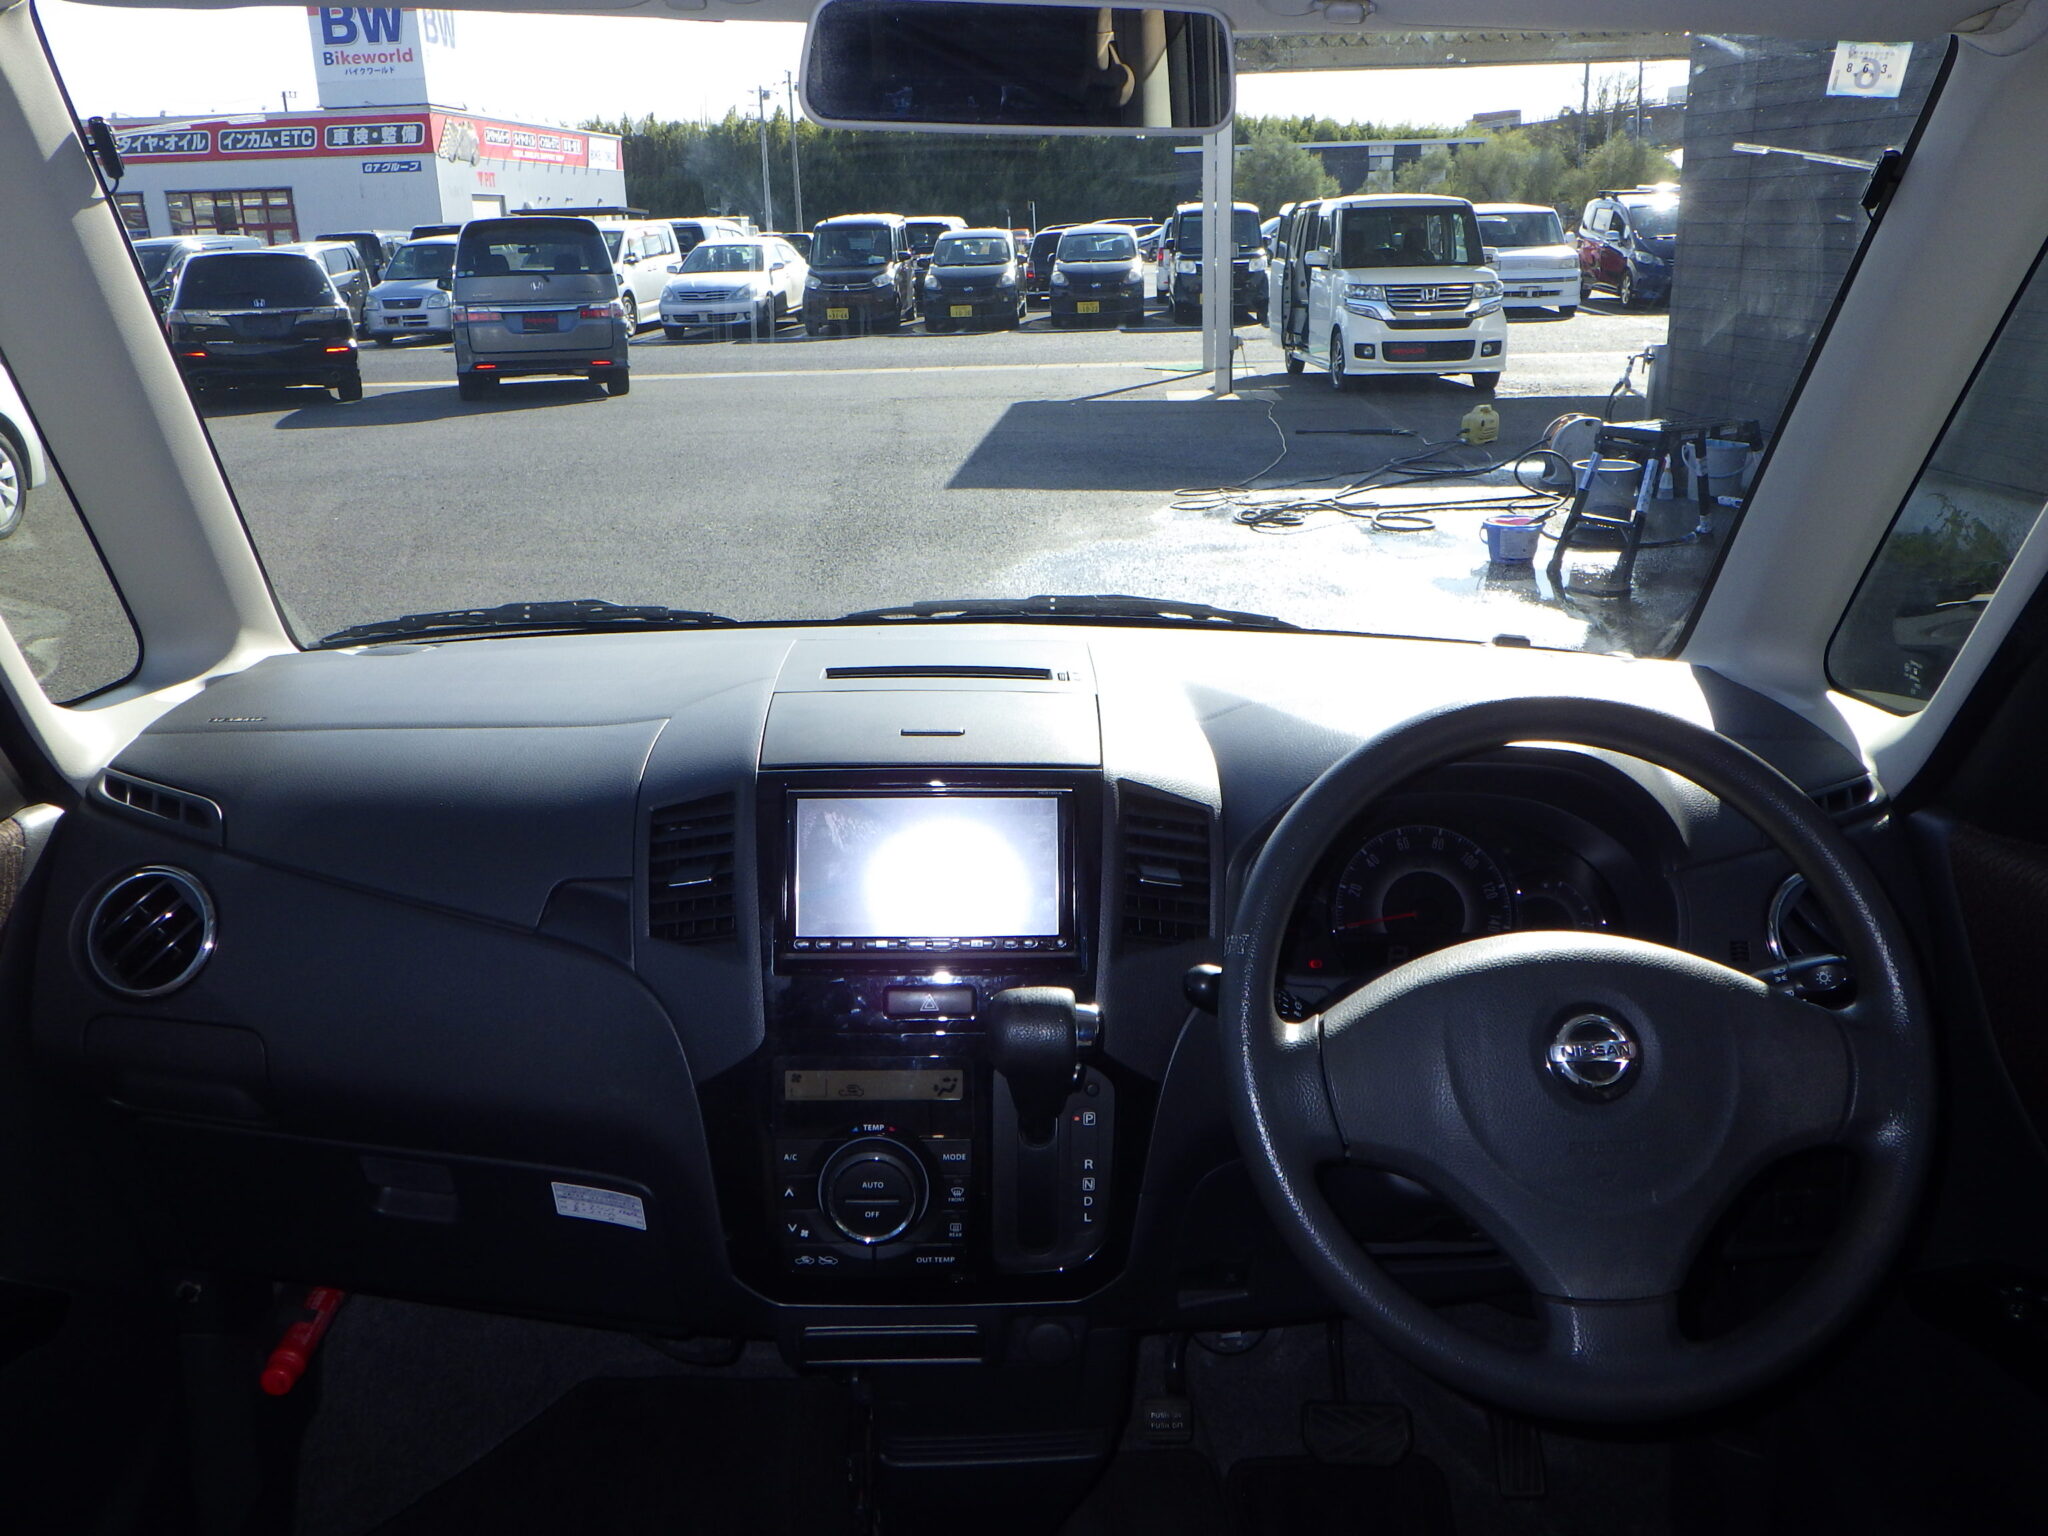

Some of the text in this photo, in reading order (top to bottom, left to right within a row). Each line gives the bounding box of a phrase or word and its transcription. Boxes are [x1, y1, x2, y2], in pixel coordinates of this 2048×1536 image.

[321, 8, 401, 45] BW
[323, 48, 414, 66] Bikeworld
[1846, 62, 1853, 73] 8
[1881, 64, 1888, 74] 3
[223, 130, 312, 149] インカム・ETC
[332, 125, 418, 145] 車検・整備
[118, 132, 206, 153] タイヤ・オイル
[1431, 836, 1445, 850] 80
[863, 1124, 885, 1132] TEMP
[783, 1153, 798, 1162] A/C
[942, 1153, 967, 1161] MODE
[1084, 1159, 1094, 1170] R
[861, 1181, 885, 1190] AUTO
[1084, 1197, 1093, 1206] D
[864, 1211, 881, 1219] OFF
[1084, 1213, 1092, 1222] L
